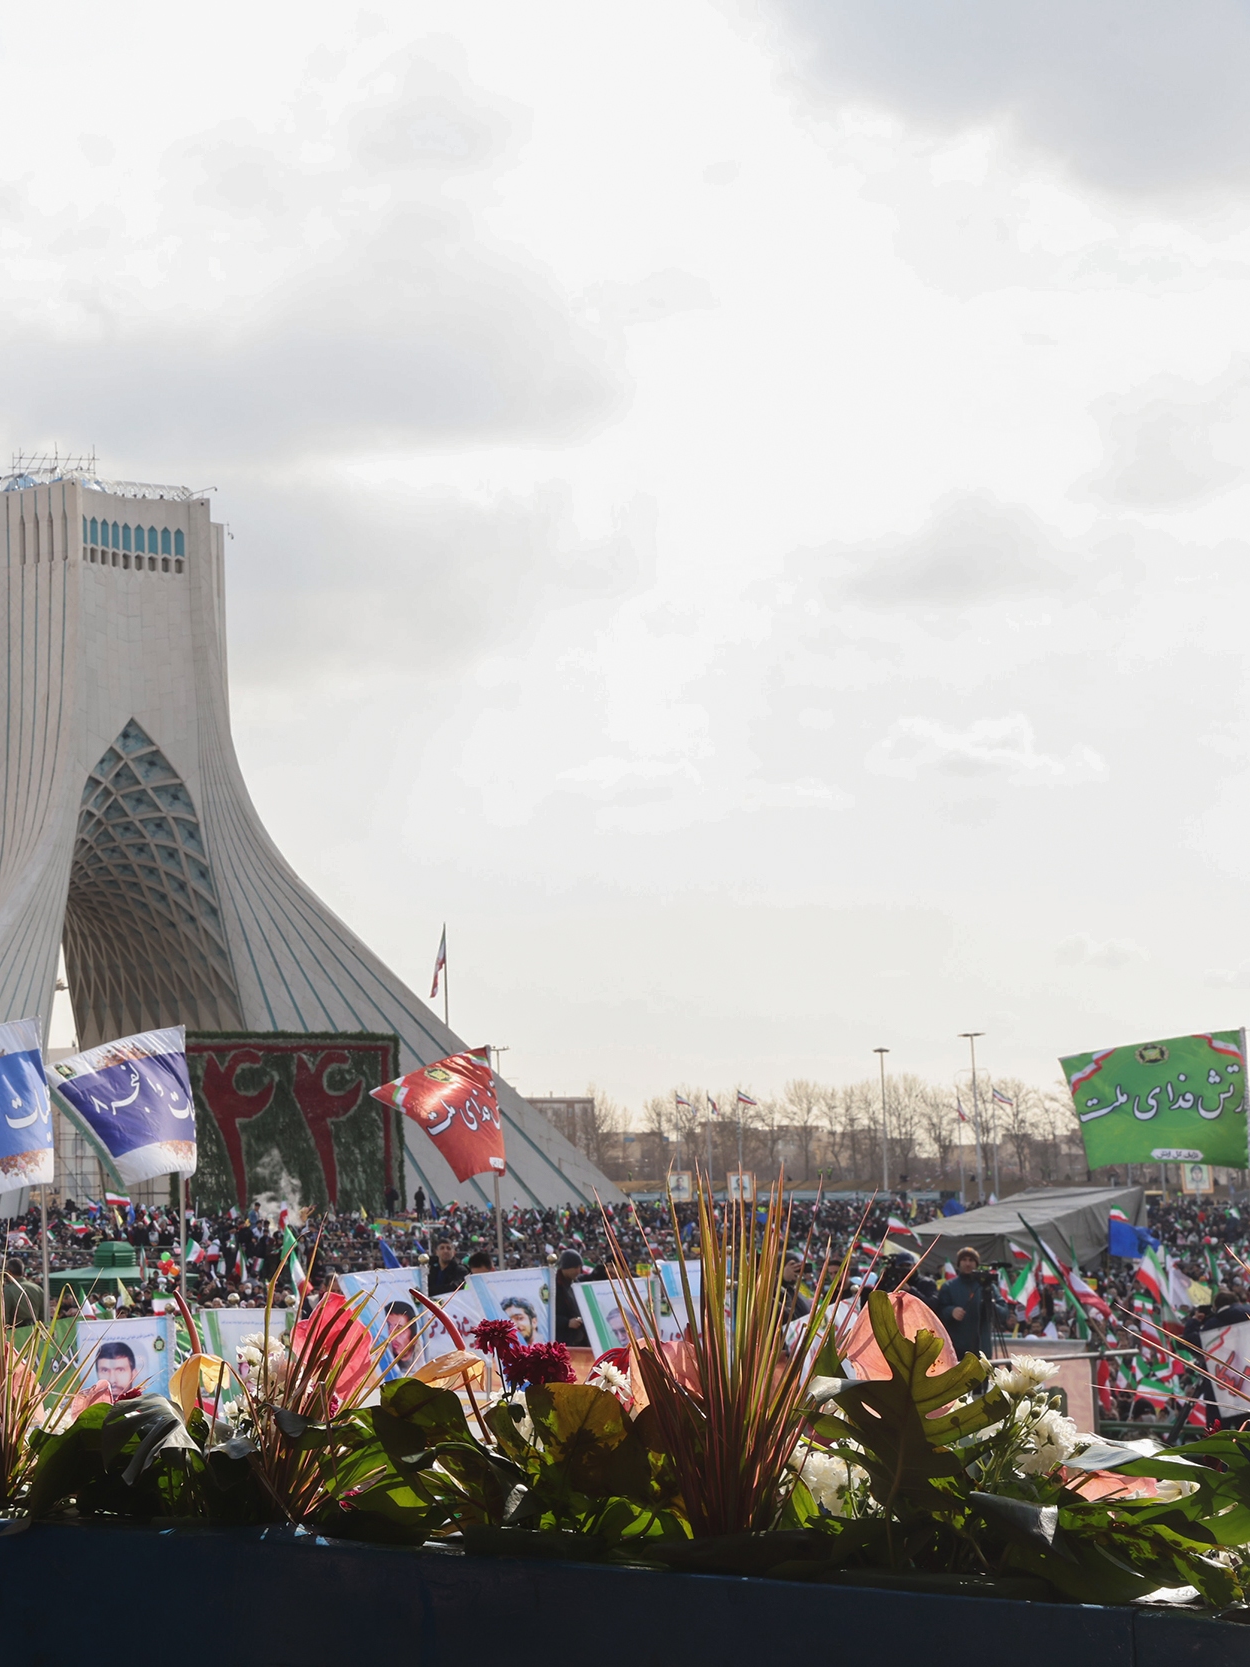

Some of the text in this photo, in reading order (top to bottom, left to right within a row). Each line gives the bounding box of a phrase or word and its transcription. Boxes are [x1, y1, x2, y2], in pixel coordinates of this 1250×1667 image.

[1079, 1083, 1129, 1123] ملت
[1133, 1073, 1195, 1121] فدای
[427, 1099, 457, 1136] ملت
